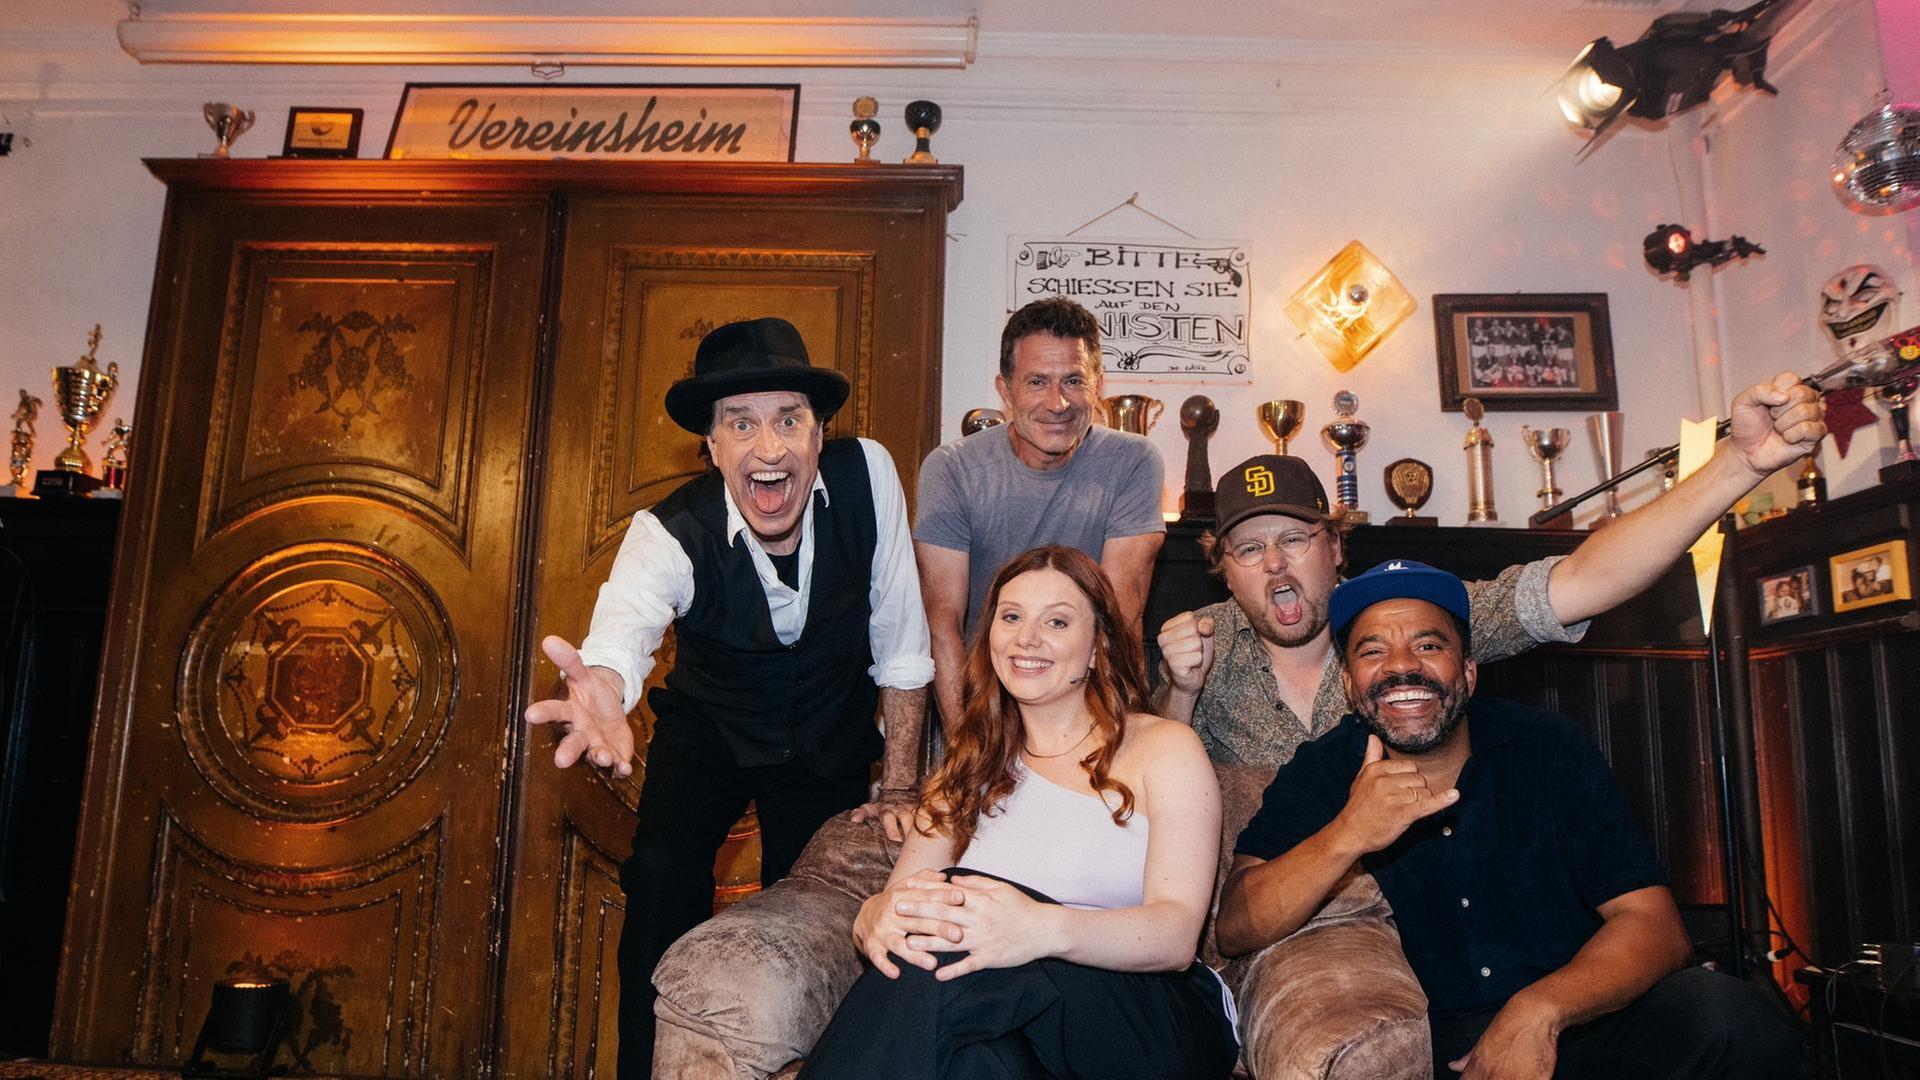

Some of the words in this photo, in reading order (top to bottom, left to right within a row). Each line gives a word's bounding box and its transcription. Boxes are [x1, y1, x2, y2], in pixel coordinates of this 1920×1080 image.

[448, 96, 746, 153] Vereinsheim
[1085, 247, 1200, 268] BITTE
[1027, 277, 1174, 297] SCHIESSEN
[1184, 281, 1237, 297] SIE
[1095, 300, 1132, 309] AUF
[1139, 302, 1180, 311] DEN
[1098, 312, 1244, 344] NISTEN
[1245, 465, 1275, 496] SD
